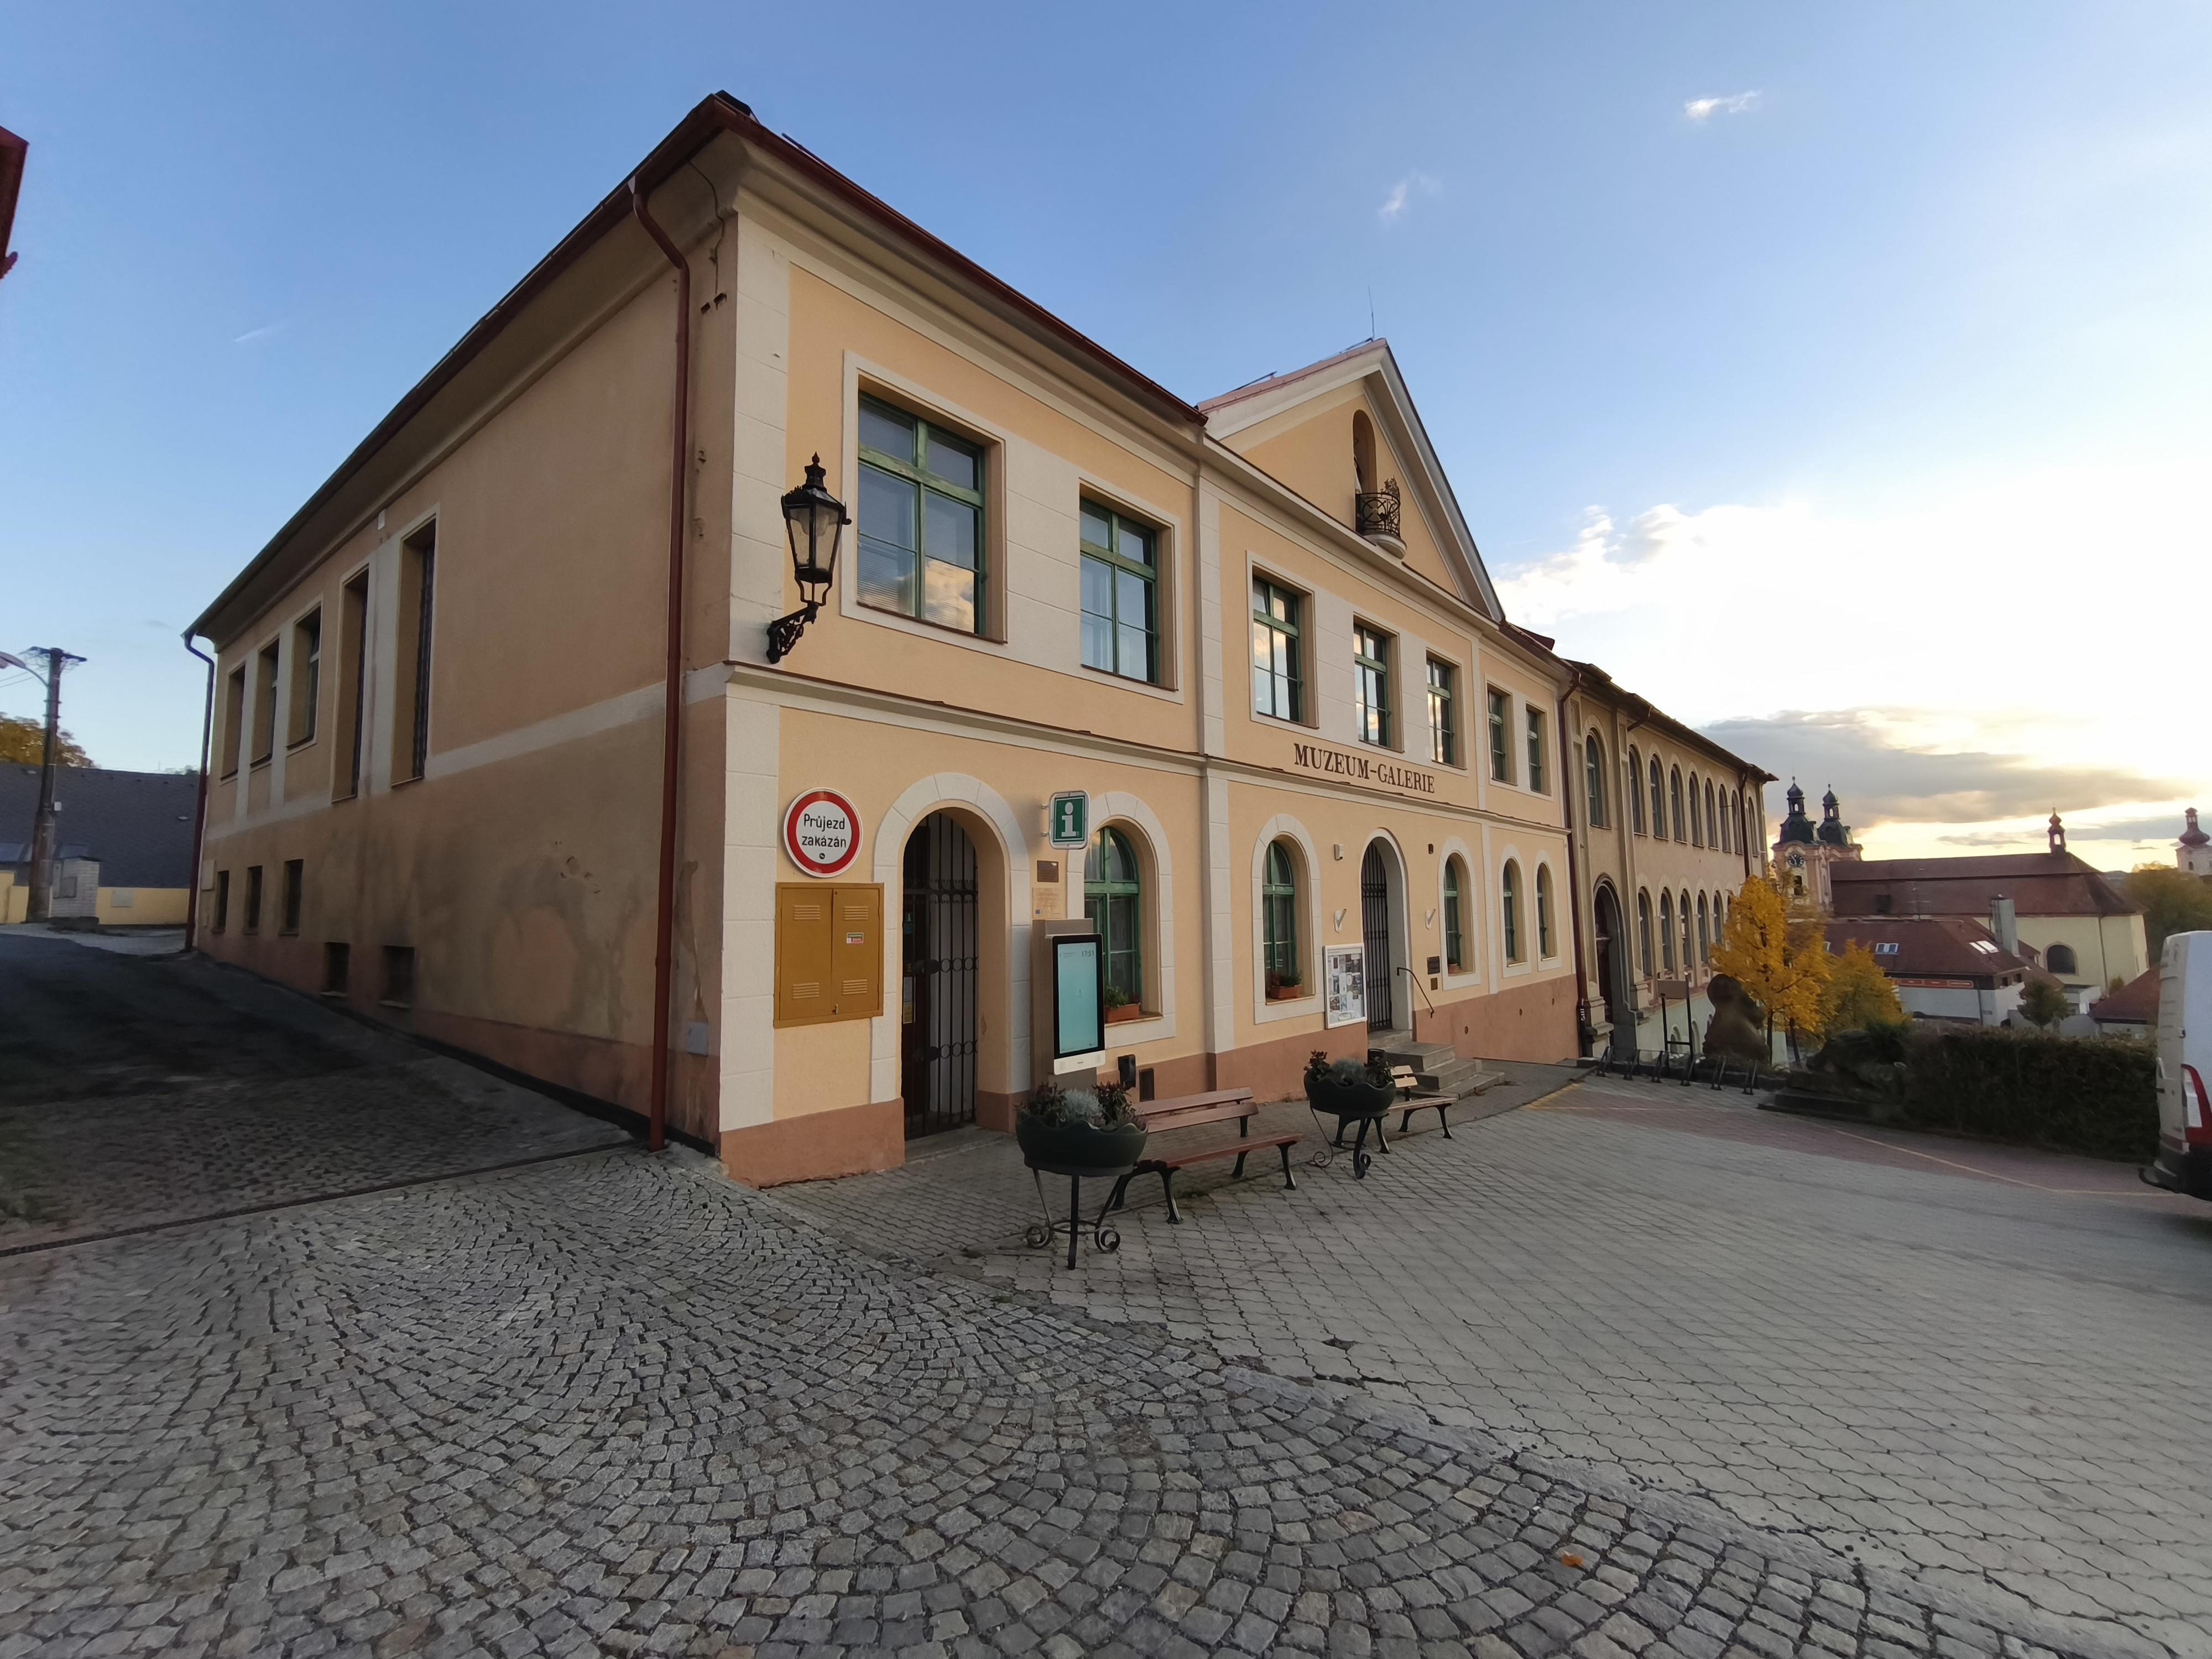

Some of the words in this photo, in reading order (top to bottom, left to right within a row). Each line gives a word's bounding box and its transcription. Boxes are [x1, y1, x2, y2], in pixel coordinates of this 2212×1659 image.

[1294, 743, 1435, 794] MUZEUM-GALERIE
[804, 813, 845, 832] Průjezd
[802, 836, 846, 848] zakázán
